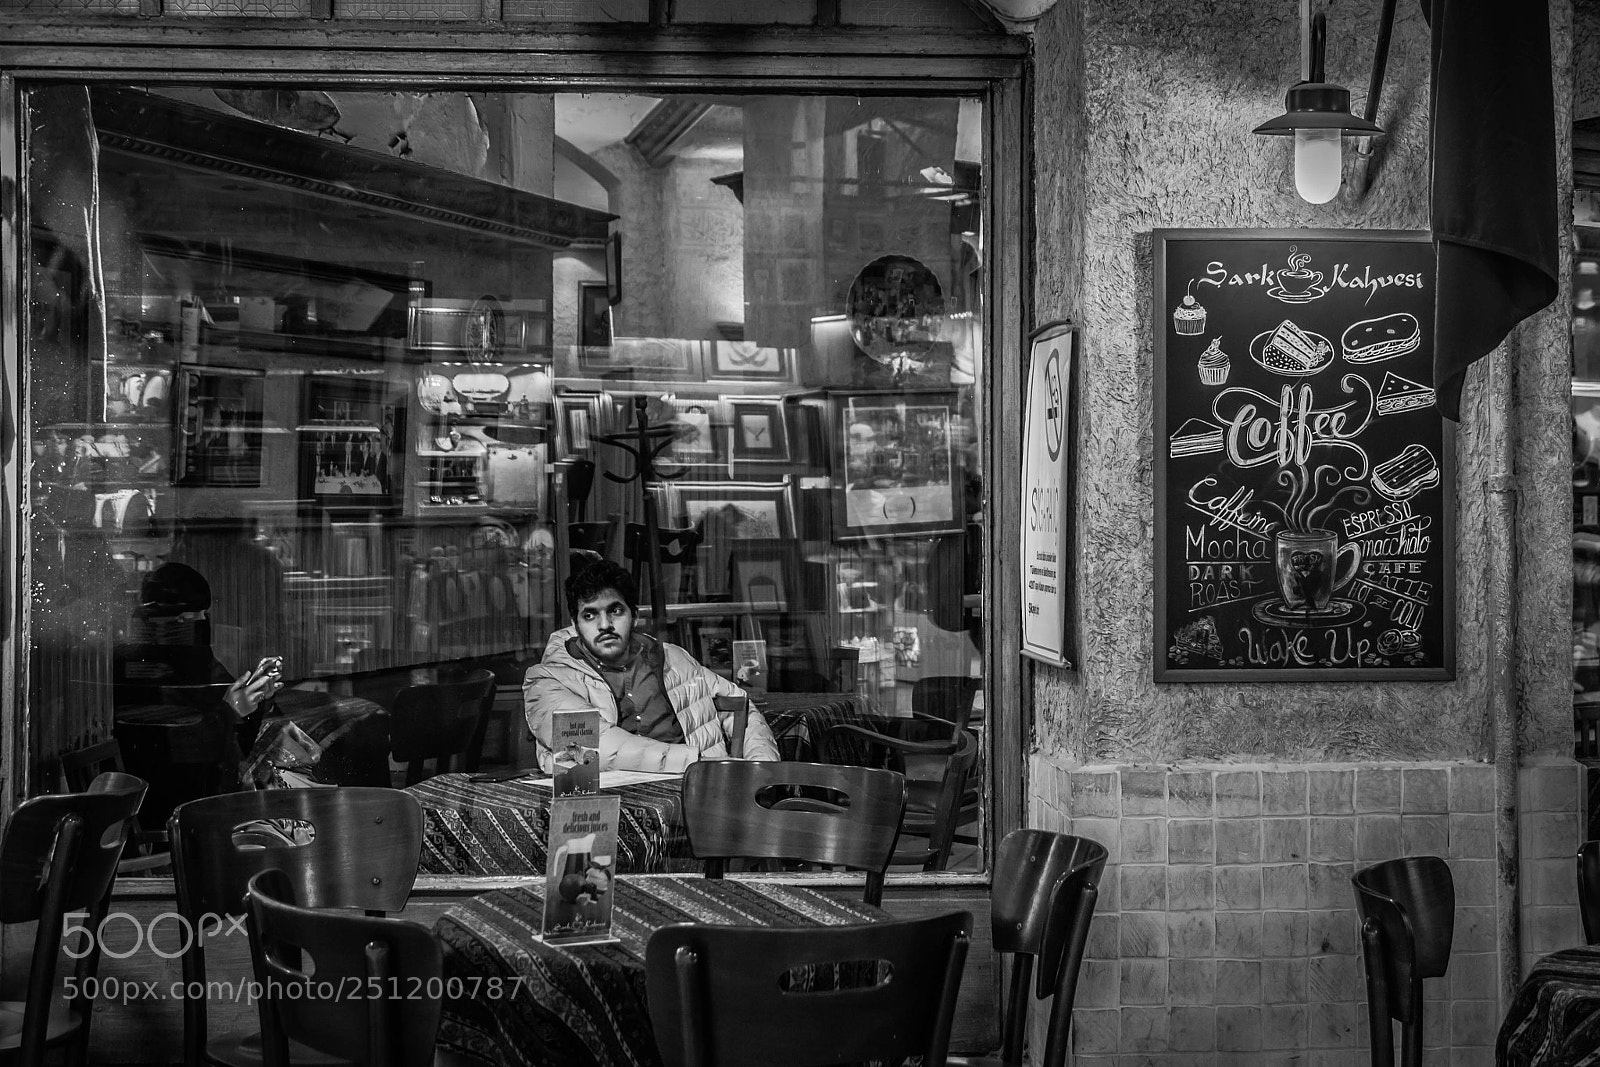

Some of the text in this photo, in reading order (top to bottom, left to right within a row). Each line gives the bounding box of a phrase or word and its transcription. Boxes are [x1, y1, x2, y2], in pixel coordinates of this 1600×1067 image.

[1323, 263, 1424, 308] Kahvesi
[1213, 374, 1373, 468] Coffee
[1188, 478, 1279, 538] Caffeine
[1342, 500, 1412, 537] ESPRESSO
[1186, 524, 1272, 560] Mocha
[1359, 516, 1432, 557] macchiato
[1188, 565, 1255, 580] DARK
[1362, 562, 1422, 574] CAFE
[1189, 579, 1264, 608] ROAST
[1364, 574, 1433, 602] LATTE
[1347, 581, 1374, 603] HOT
[1390, 599, 1424, 632] COLD
[562, 822, 590, 834] delicious
[572, 810, 601, 822] fresh and
